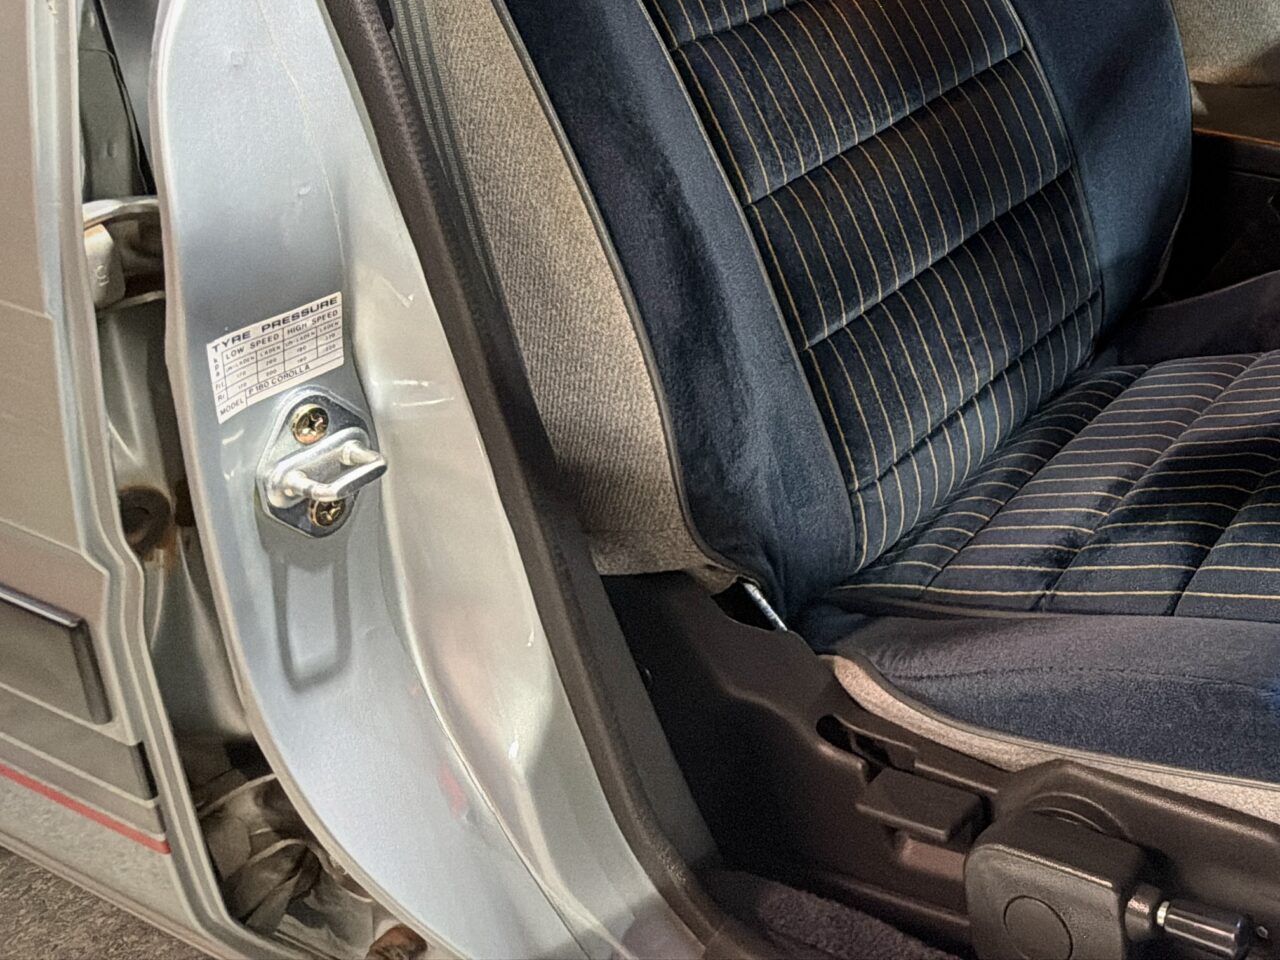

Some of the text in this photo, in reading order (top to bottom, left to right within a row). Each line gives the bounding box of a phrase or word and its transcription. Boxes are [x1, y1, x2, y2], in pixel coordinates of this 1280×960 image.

[212, 296, 338, 352] TYRE PRESSURE
[287, 309, 338, 336] HIGH SPEED
[225, 333, 280, 360] LOW SPEED
[271, 363, 311, 385] COROLLA
[219, 397, 244, 415] MODEL
